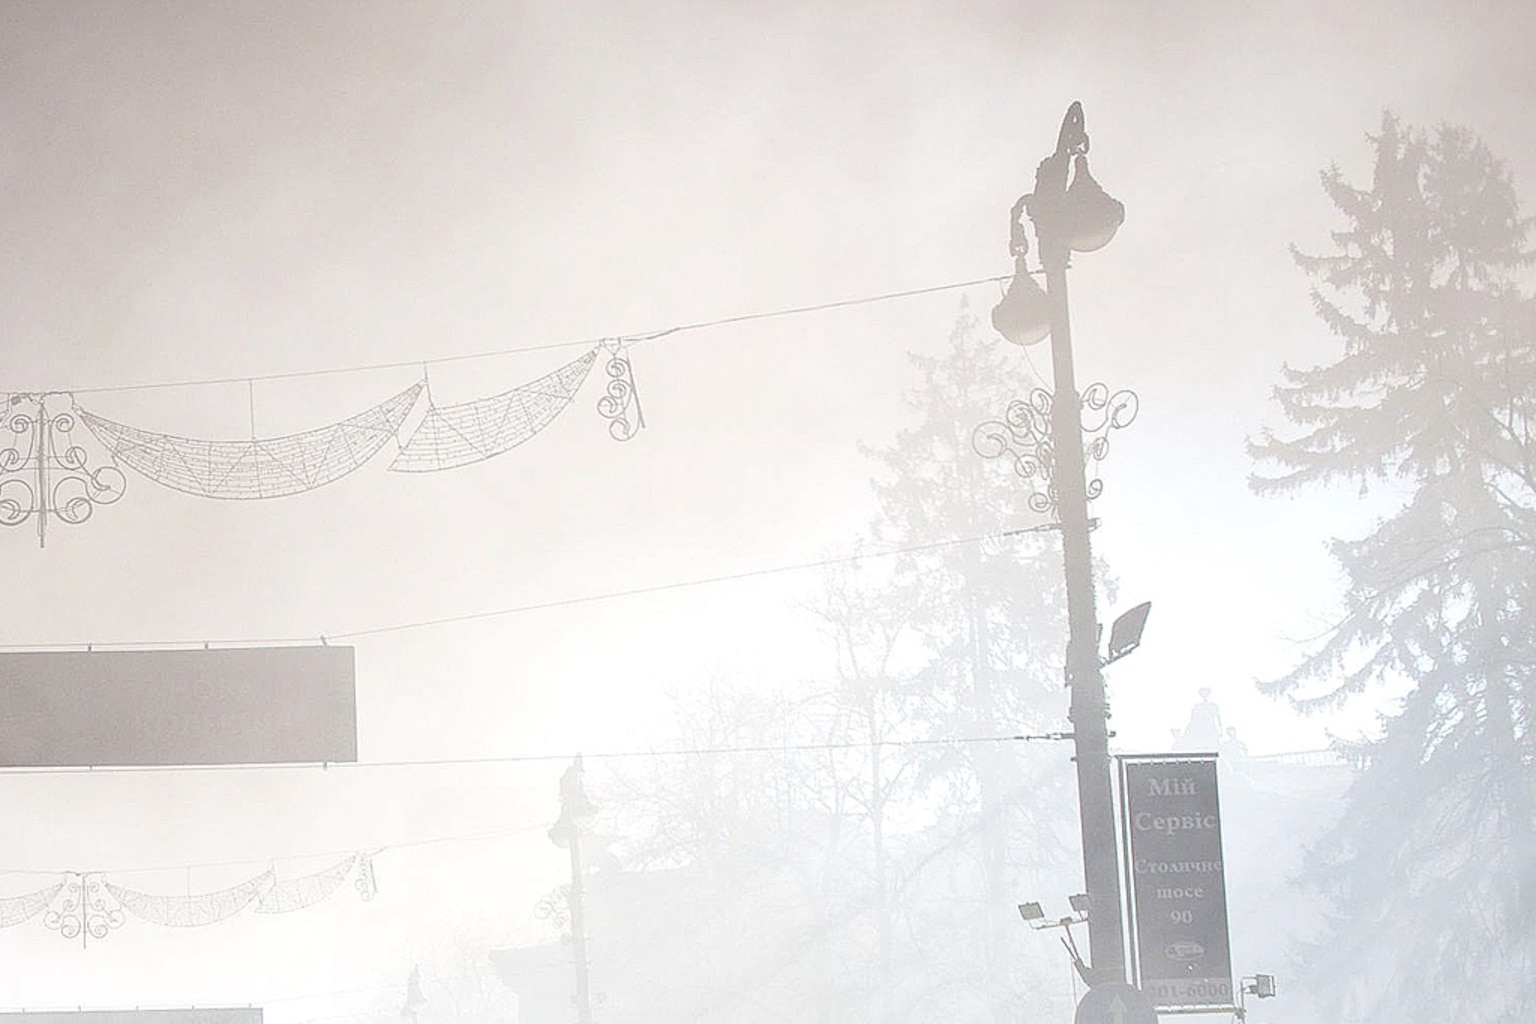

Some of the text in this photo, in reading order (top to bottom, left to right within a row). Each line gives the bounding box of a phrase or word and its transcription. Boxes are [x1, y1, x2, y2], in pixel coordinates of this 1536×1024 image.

[1148, 778, 1197, 796] Мій
[1135, 812, 1217, 835] Сервіс
[1134, 859, 1222, 875] Столичне
[1170, 910, 1193, 924] 90
